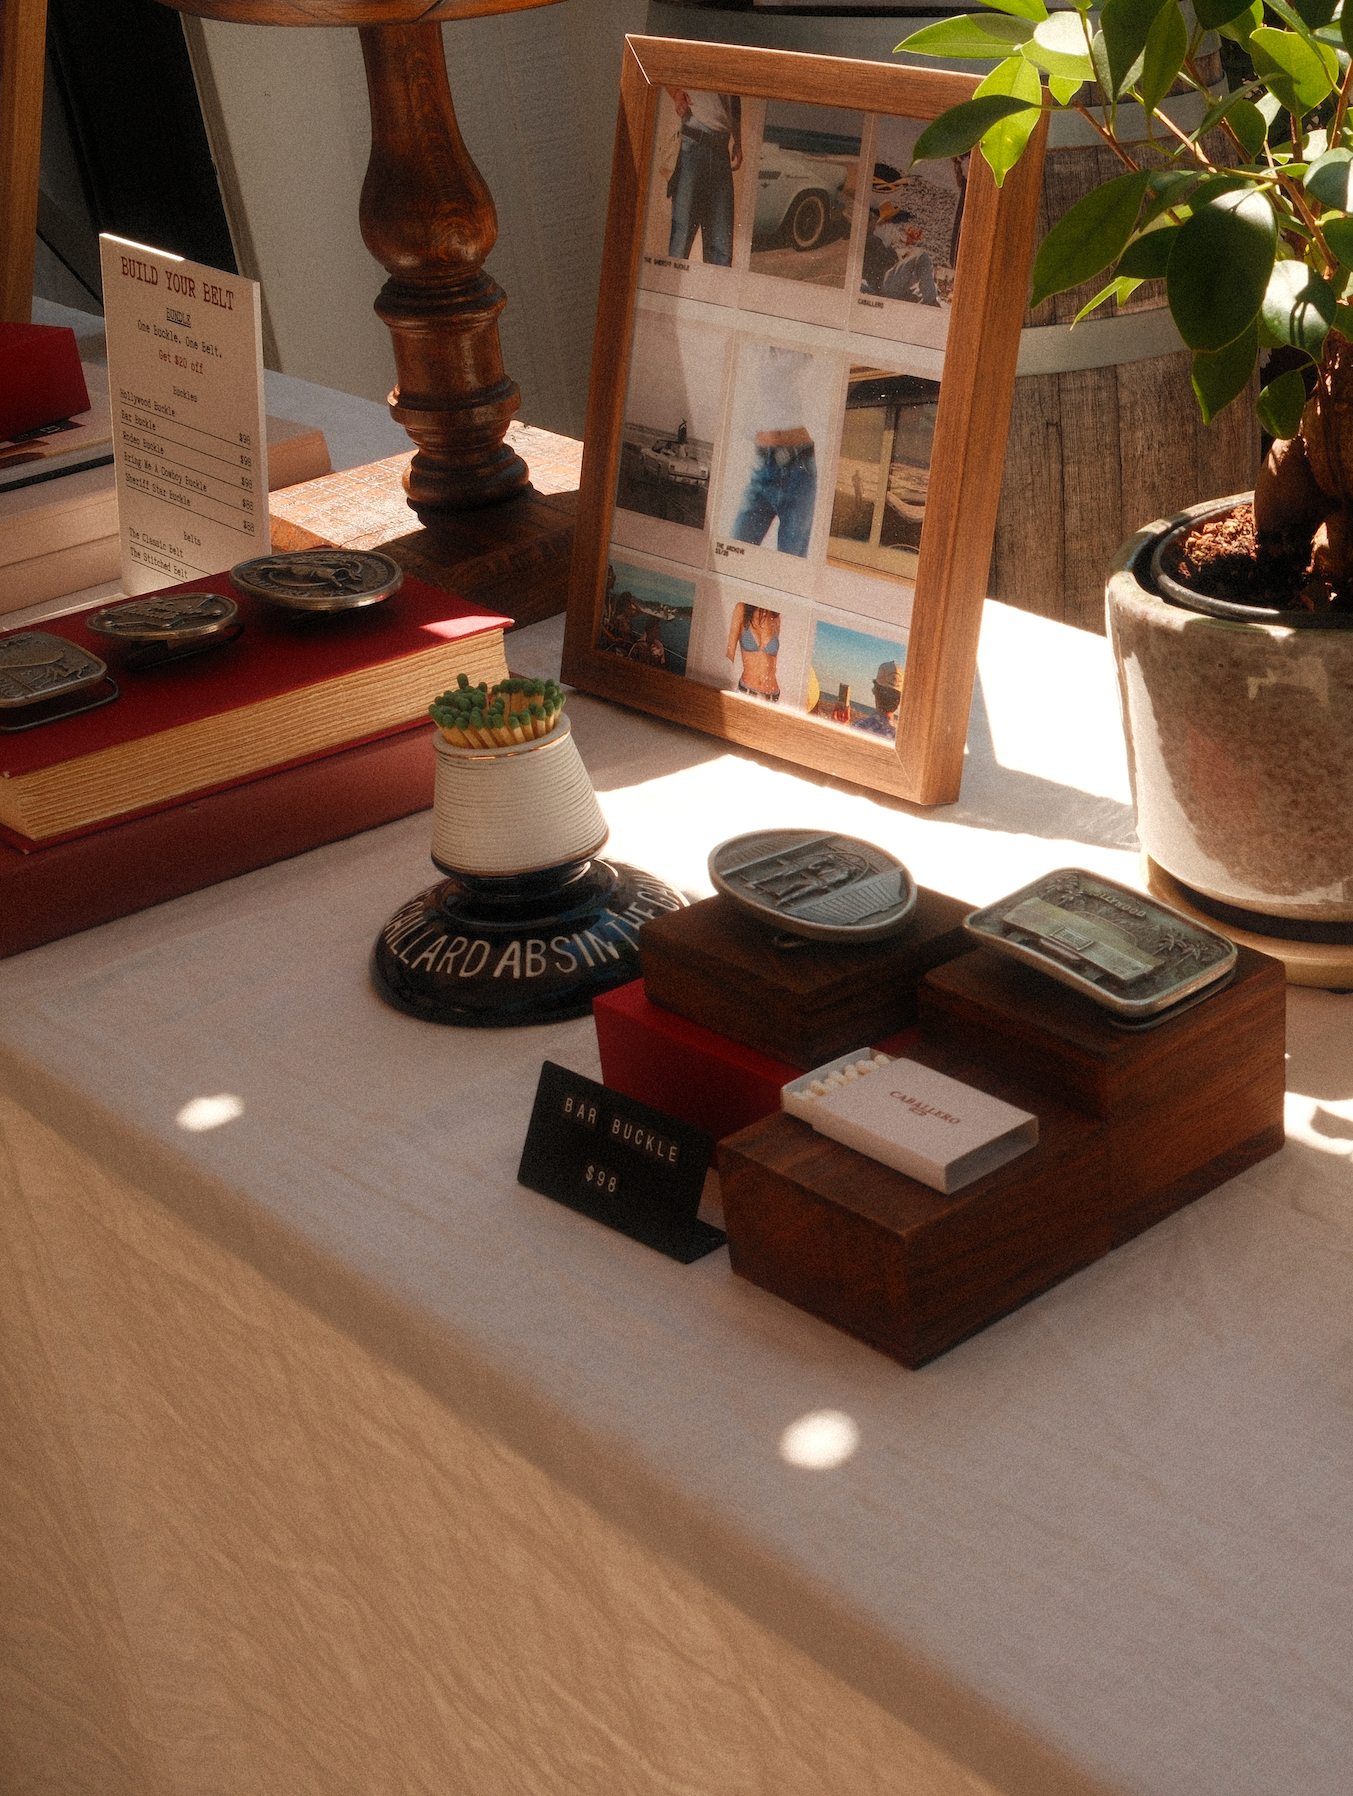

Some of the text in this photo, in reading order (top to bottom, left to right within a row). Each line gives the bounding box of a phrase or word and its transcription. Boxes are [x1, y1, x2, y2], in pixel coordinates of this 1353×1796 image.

[121, 256, 234, 311] BUILD YOUR BELT
[166, 307, 192, 327] BUNDLE
[137, 319, 222, 359] One Buckle. One Belt.
[158, 349, 204, 375] Get $20 off
[119, 387, 151, 408] Hollywood
[153, 400, 176, 417] Buckle
[172, 385, 198, 403] Buckles
[121, 409, 132, 422] Bar
[134, 414, 156, 431] Buckle
[122, 430, 140, 445] Rodeo
[142, 438, 164, 455] Buckle
[123, 451, 141, 470] Bring
[144, 459, 152, 471] Me
[161, 466, 183, 485] Cowboy
[185, 475, 207, 493] Buckle
[125, 472, 150, 490] Sheriff
[152, 482, 166, 497] Star
[168, 489, 191, 507] Buckle
[128, 526, 184, 558] The Classic Belt
[183, 531, 201, 546] Belts
[130, 546, 188, 580] The Stitched Belt
[889, 1090, 961, 1125] CABALLERO
[564, 1097, 678, 1163] BAR BUCKLE
[585, 1165, 617, 1193] $98
